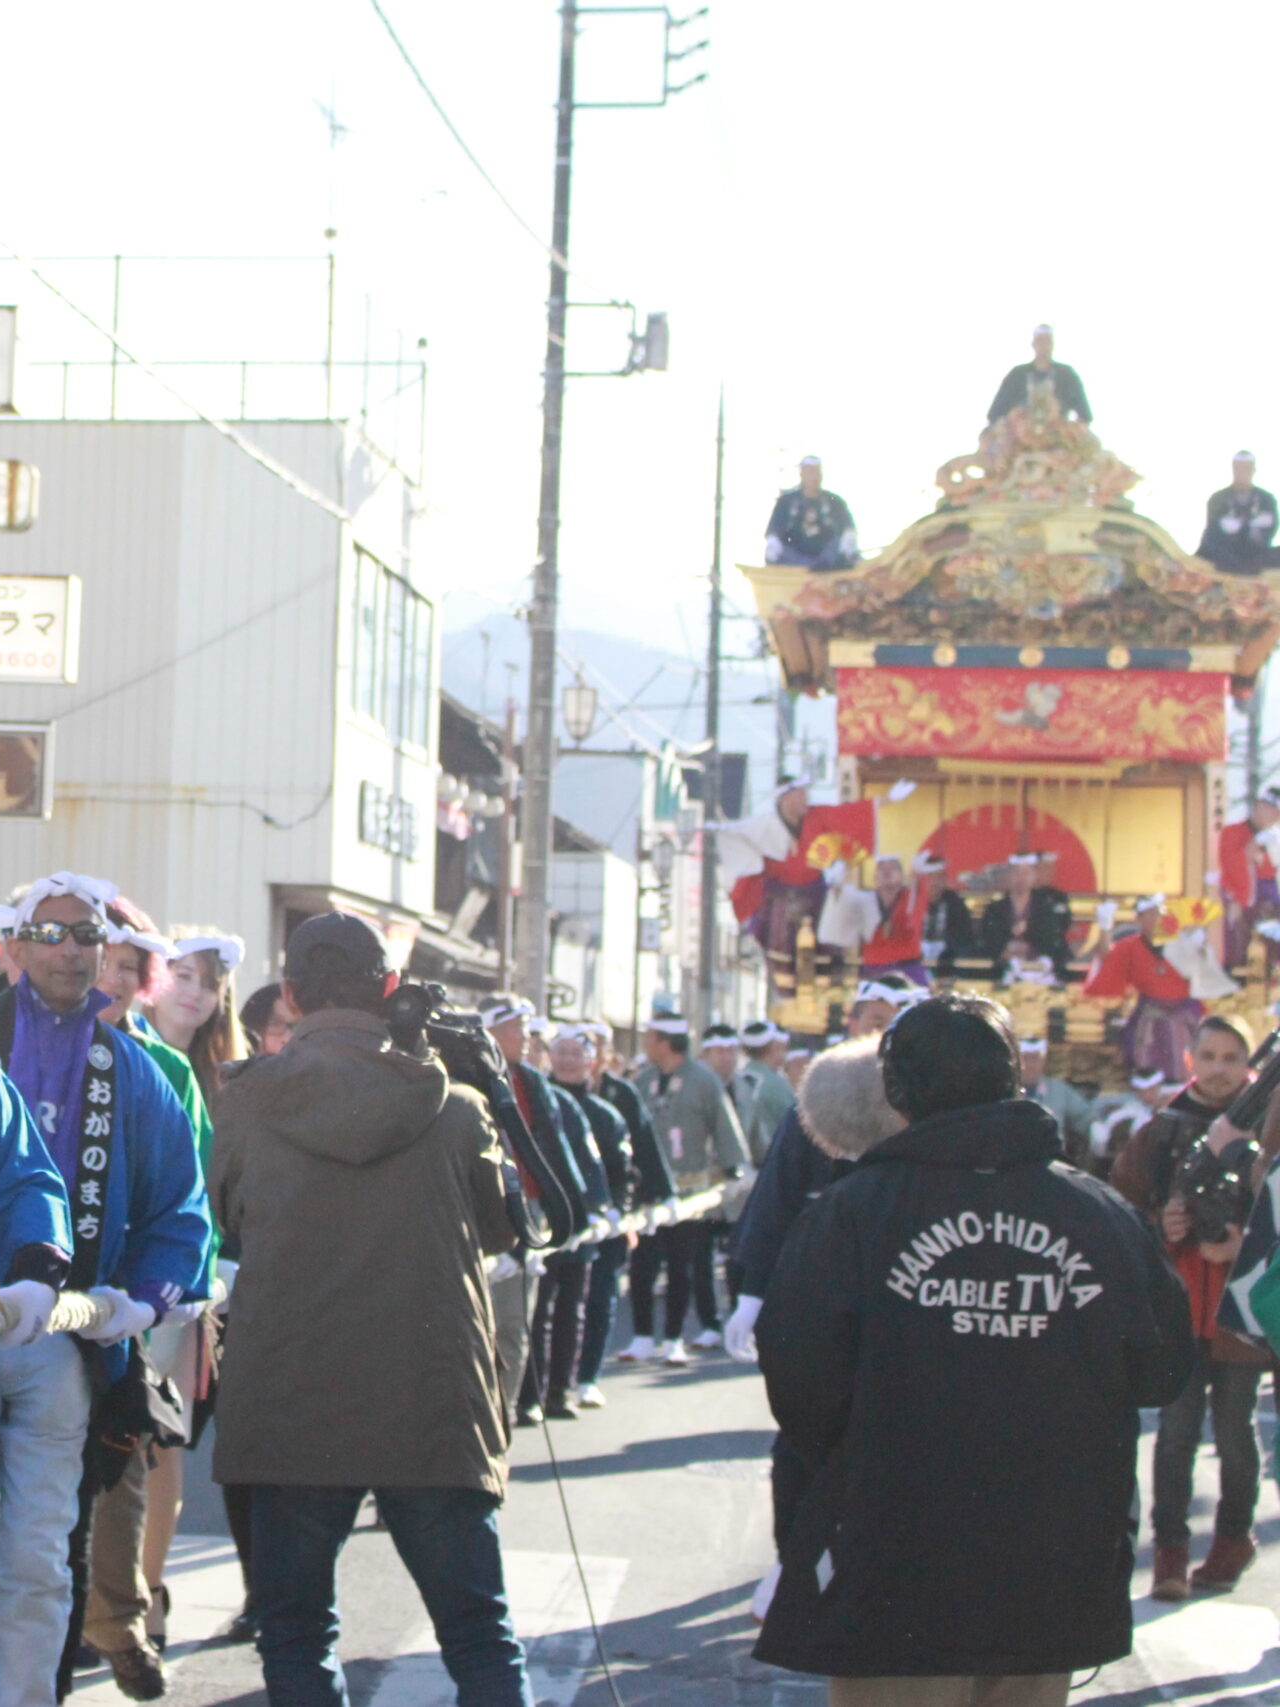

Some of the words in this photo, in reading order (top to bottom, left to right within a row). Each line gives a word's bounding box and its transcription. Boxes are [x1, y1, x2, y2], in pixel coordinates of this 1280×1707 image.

[76, 1076, 113, 1241] おがのまち
[920, 1278, 1011, 1310] CABLE
[1016, 1273, 1065, 1312] TV
[952, 1310, 1049, 1338] STAFF
